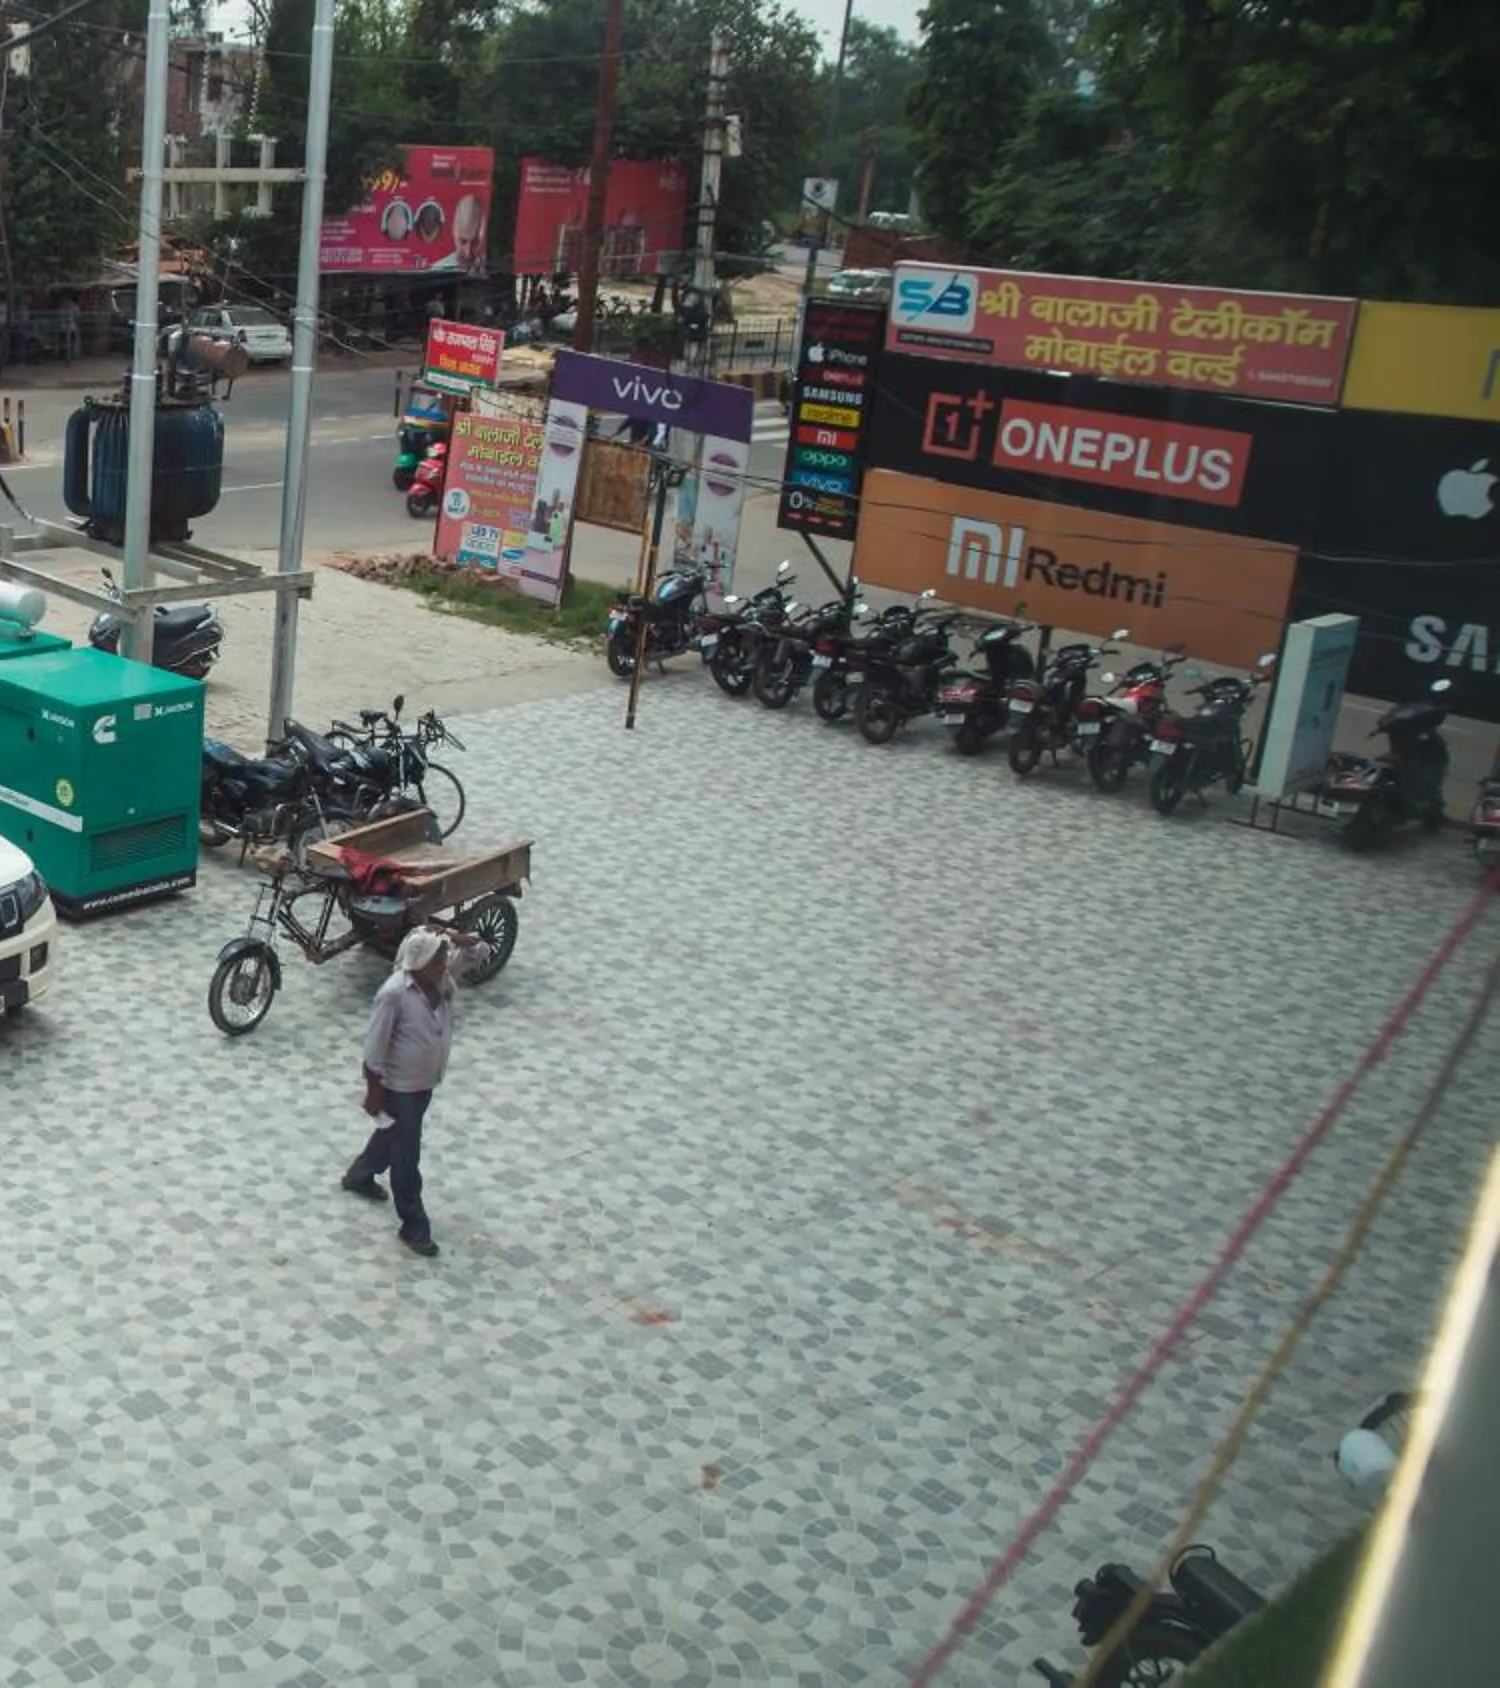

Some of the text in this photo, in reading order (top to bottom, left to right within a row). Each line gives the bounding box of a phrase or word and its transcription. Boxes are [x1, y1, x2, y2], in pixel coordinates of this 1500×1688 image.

[979, 281, 1021, 318] श्री
[1168, 298, 1338, 348] टेलीकॉम
[1024, 327, 1246, 387] मोबाईल वर्ल्ड
[612, 375, 684, 410] vivo
[803, 386, 863, 405] SAMSUNG
[1000, 418, 1233, 491] ONEPLUS
[1023, 546, 1168, 609] Redmi
[1405, 614, 1500, 675] SA
